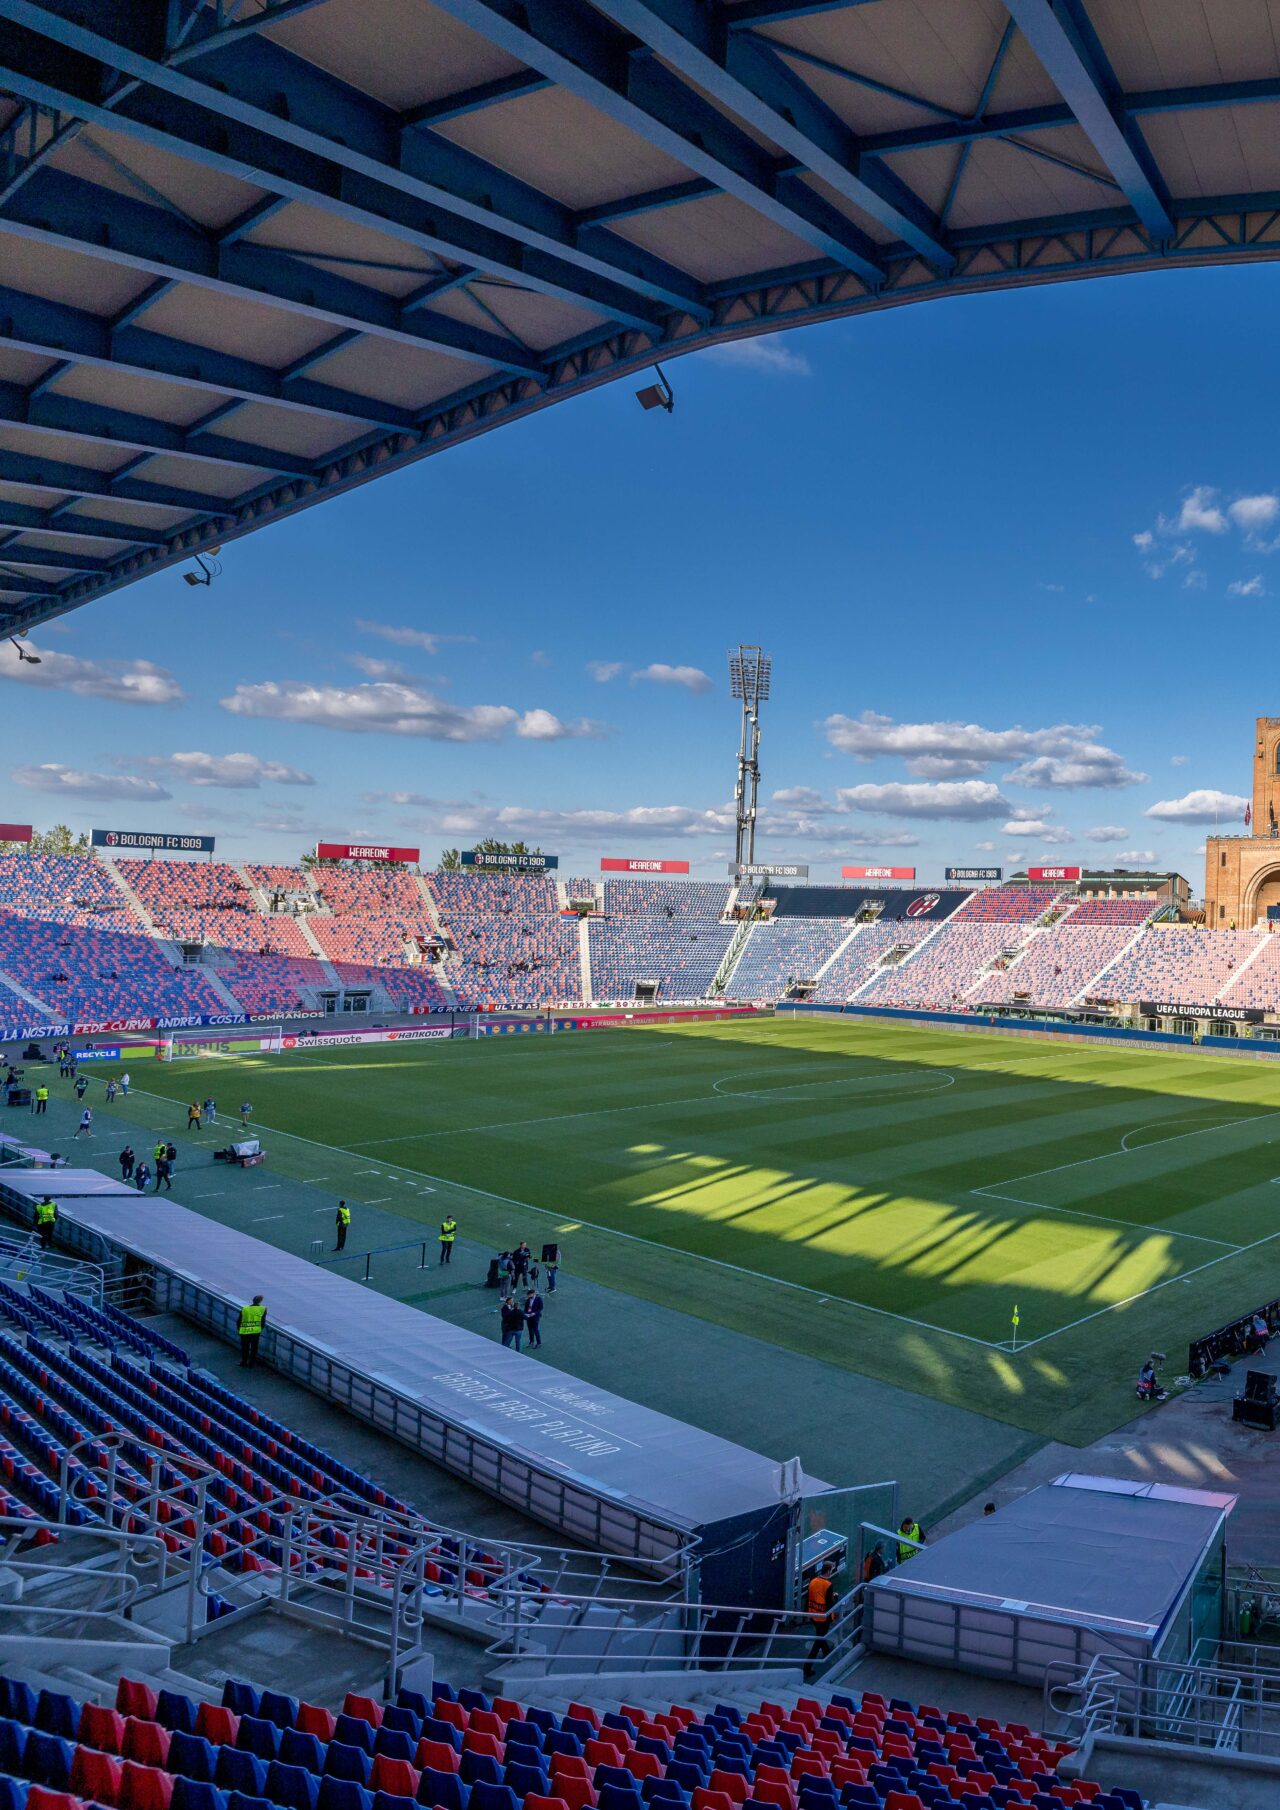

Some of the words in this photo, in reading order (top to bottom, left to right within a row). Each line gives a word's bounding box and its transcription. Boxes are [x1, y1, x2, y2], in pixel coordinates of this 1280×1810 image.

[120, 834, 164, 847] BOLOGNA
[166, 837, 178, 847] FC
[180, 838, 202, 848] 1909
[349, 848, 390, 858] WEAREONE
[485, 854, 517, 865] BOLOGNA
[518, 856, 528, 865] FC
[529, 857, 545, 866] 1909
[629, 860, 662, 870] WEAREONE
[865, 868, 892, 877] WEAREONE
[956, 869, 978, 879] BOLOGNA
[979, 870, 985, 879] FC
[986, 870, 997, 879] 1909
[1042, 869, 1065, 878] WEAREONE
[250, 1012, 325, 1022] COMMANDOS
[1156, 1005, 1178, 1014] UEFA
[1179, 1006, 1211, 1017] EUROPA
[1213, 1008, 1245, 1019] LEAGUE
[73, 1022, 105, 1034] FEDE
[110, 1019, 152, 1031] CURVA
[156, 1016, 202, 1028] ANDREA
[209, 1014, 246, 1025] COSTA
[2, 1030, 18, 1042] LA
[21, 1024, 69, 1038] NOSTRA
[298, 1034, 362, 1047] Swissquote
[76, 1050, 116, 1058] RECYCLE
[432, 1372, 508, 1401] GARDEN
[486, 1400, 547, 1422] AREA
[529, 1420, 620, 1456] PLATINO
